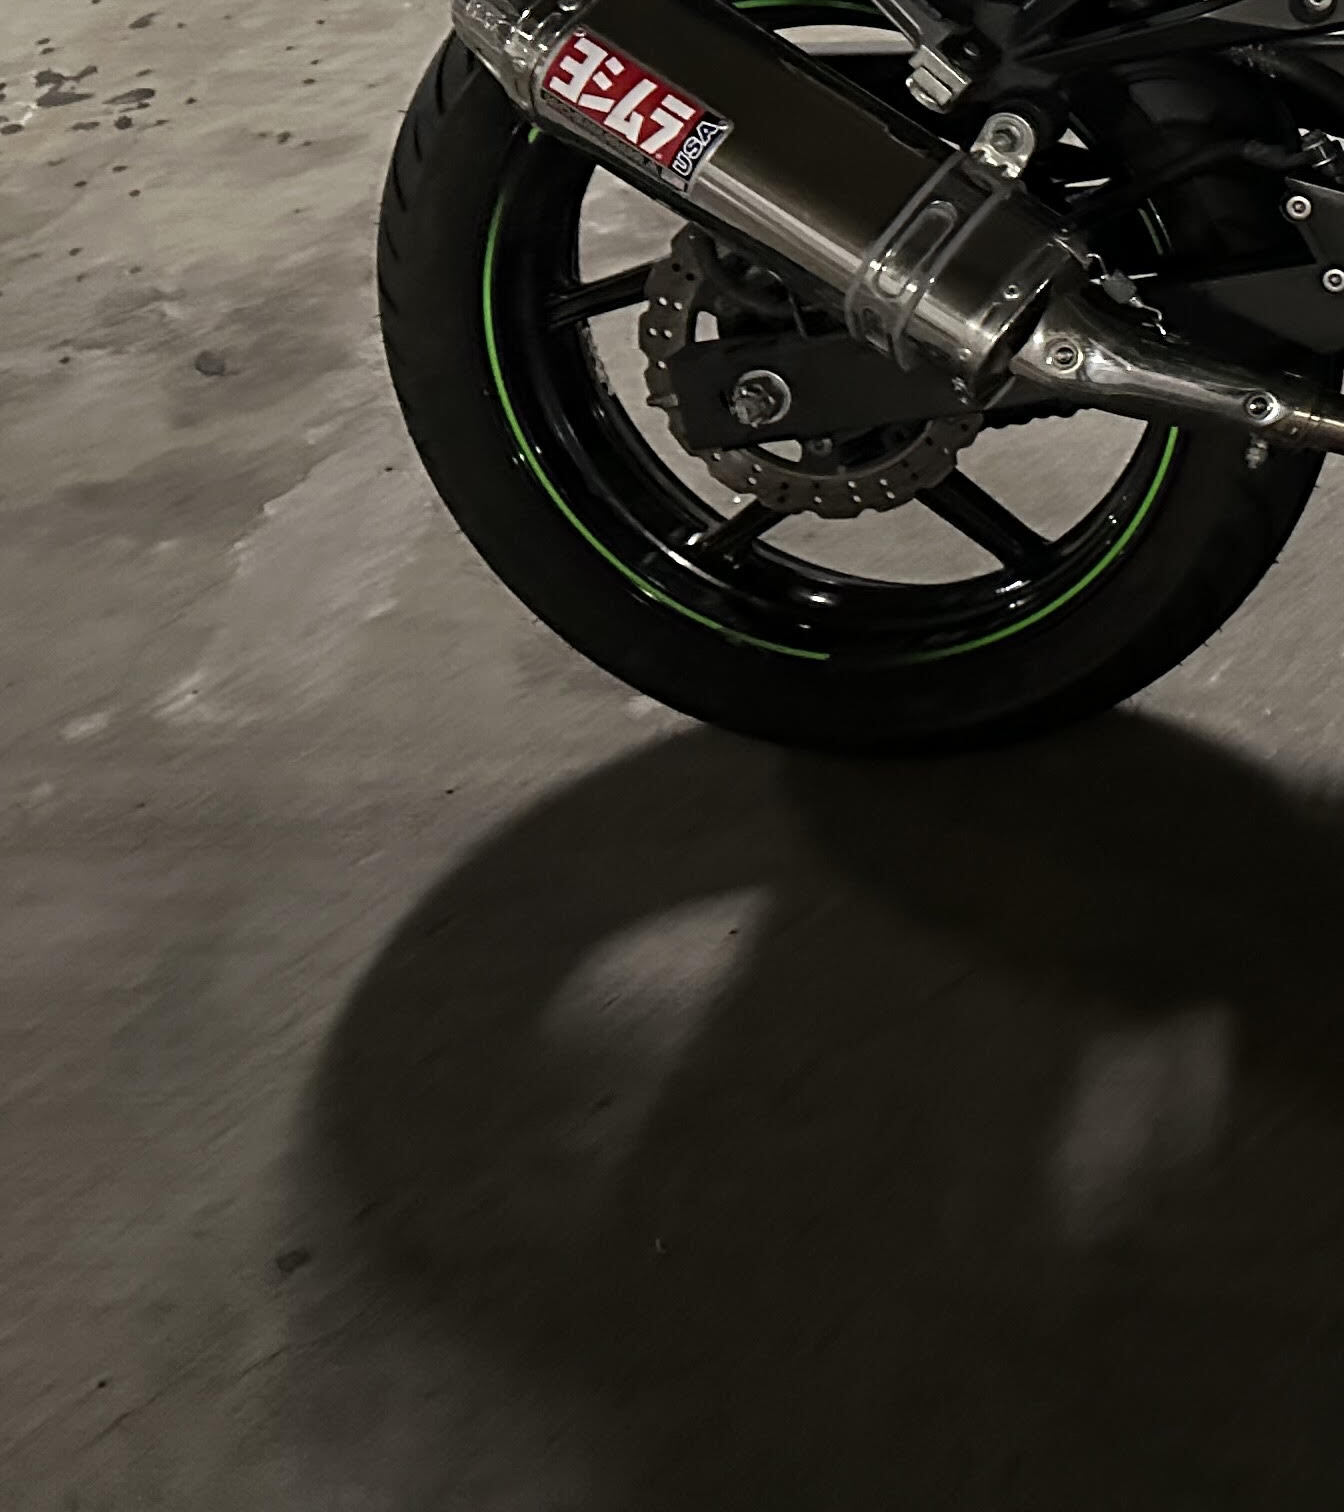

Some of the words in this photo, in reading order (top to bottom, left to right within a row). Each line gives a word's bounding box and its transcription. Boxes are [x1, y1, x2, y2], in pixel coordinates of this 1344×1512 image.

[549, 37, 696, 155] ヨシムラ
[672, 120, 724, 177] USA
